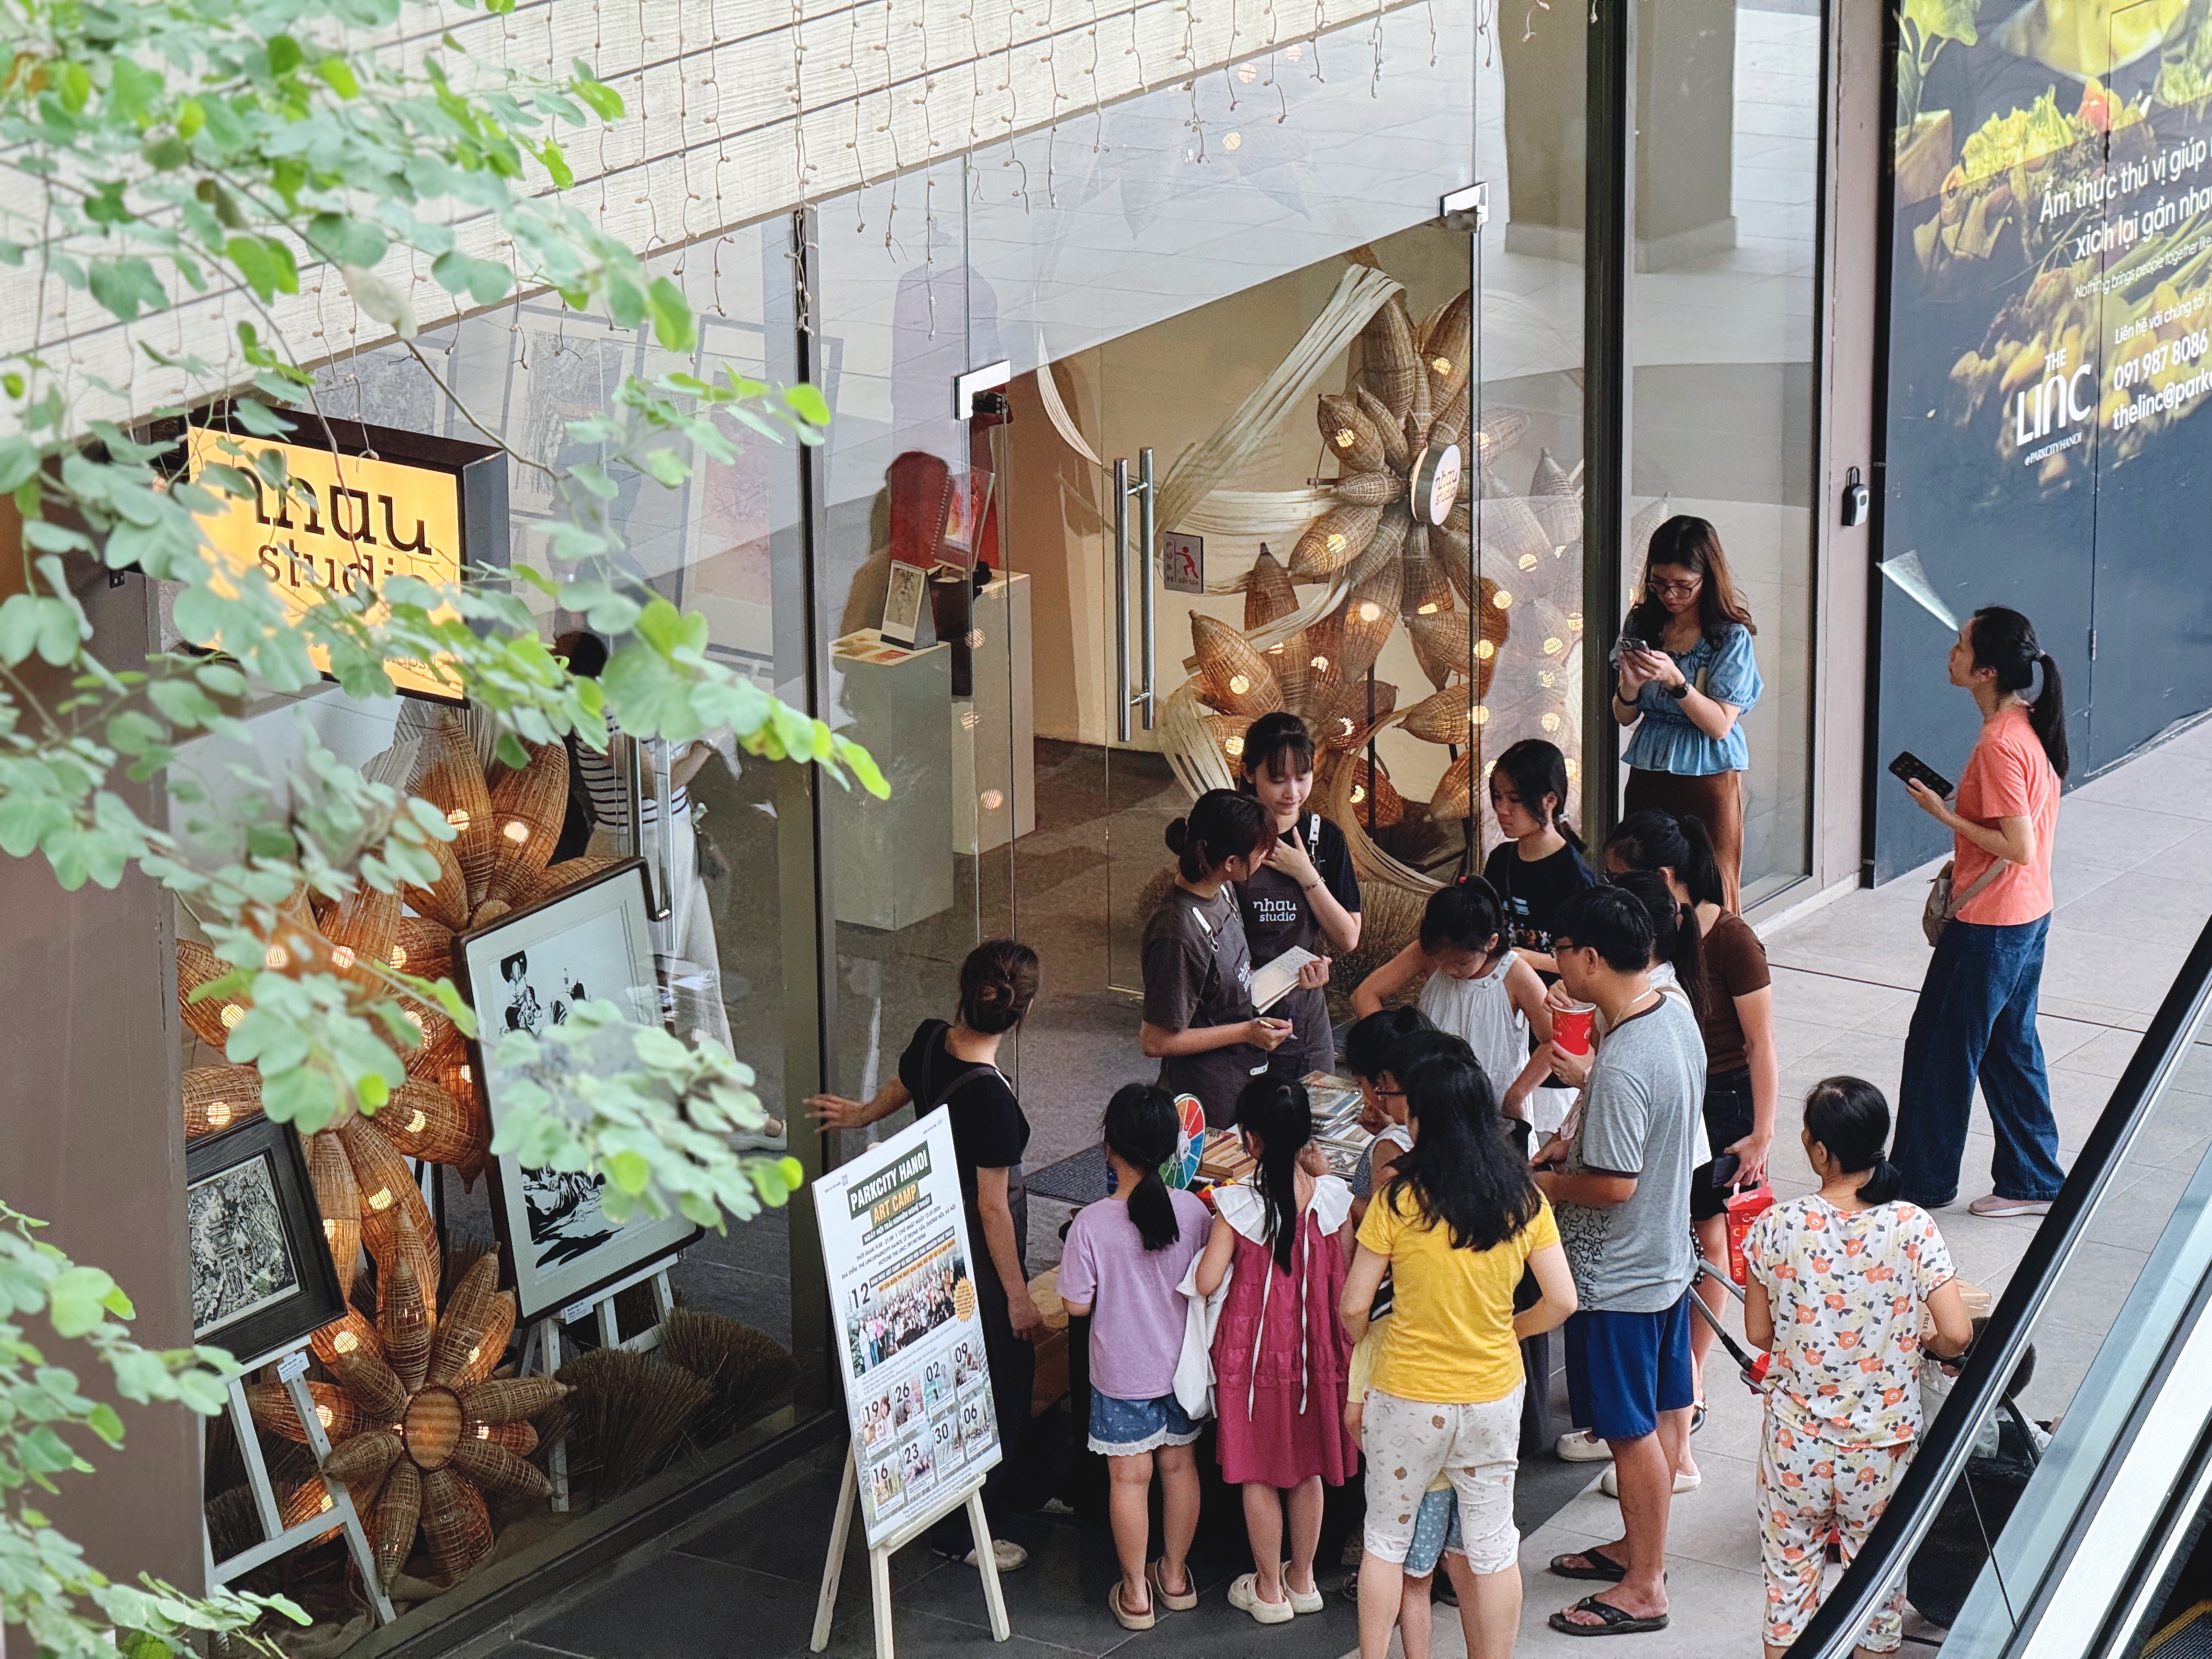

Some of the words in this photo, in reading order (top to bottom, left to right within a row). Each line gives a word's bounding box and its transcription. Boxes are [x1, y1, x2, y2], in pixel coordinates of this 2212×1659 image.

[2040, 176, 2070, 223] Ẩm
[2075, 173, 2117, 210] thực
[2121, 155, 2148, 194] thú
[2152, 149, 2166, 186] vị
[2170, 137, 2207, 182] giúp
[2075, 219, 2113, 260] xích
[2118, 210, 2138, 250] lại
[2142, 195, 2175, 242] gần
[2180, 186, 2212, 220] nha
[2074, 278, 2111, 300] Nothing
[2112, 269, 2135, 286] brings
[2136, 255, 2164, 281] people
[2166, 240, 2199, 267] together
[2115, 324, 2134, 345] Liên
[2136, 316, 2147, 337] hệ
[2149, 311, 2163, 329] với
[2164, 300, 2192, 323] chúng
[2193, 290, 2205, 310] tôi
[2045, 347, 2067, 372] THE
[2114, 358, 2138, 391] 091
[2142, 345, 2169, 379] 987
[2172, 328, 2208, 366] 8086
[2059, 431, 2082, 452] HANOI
[1435, 469, 1458, 490] nhau
[1435, 485, 1456, 506] studio
[258, 539, 431, 599] stud
[1253, 898, 1297, 912] nhau
[1259, 912, 1296, 922] studio
[850, 1166, 898, 1212] PARKCITY
[899, 1150, 929, 1185] HANOI
[873, 1199, 891, 1224] ART
[891, 1183, 917, 1212] CAMP
[851, 1282, 870, 1310] 12
[1922, 1313, 1930, 1330] FREE
[955, 1342, 968, 1363] 09
[926, 1361, 940, 1383] 02
[895, 1381, 910, 1404] 26
[865, 1400, 879, 1423] 19
[963, 1403, 978, 1424] 06
[934, 1423, 949, 1444] 30
[904, 1442, 919, 1465] 23
[873, 1462, 888, 1482] 16
